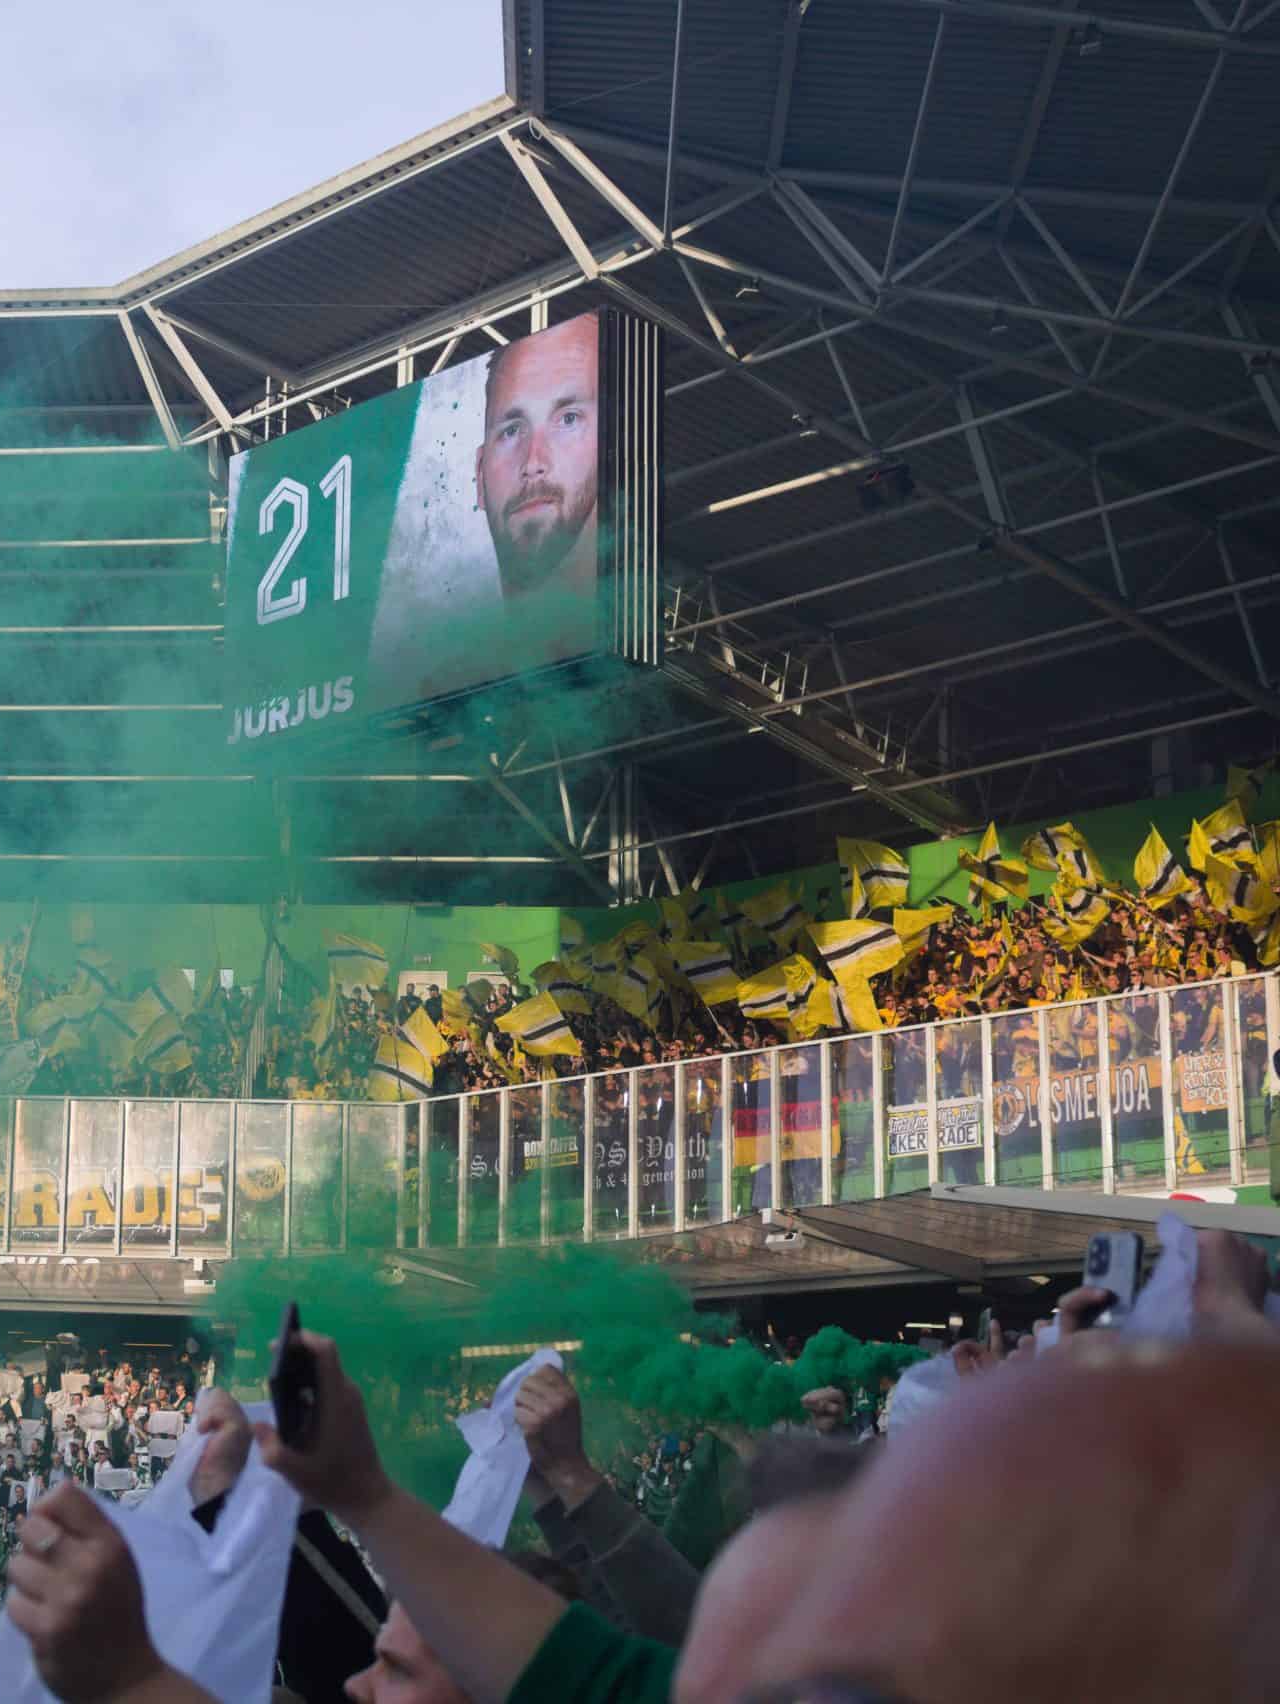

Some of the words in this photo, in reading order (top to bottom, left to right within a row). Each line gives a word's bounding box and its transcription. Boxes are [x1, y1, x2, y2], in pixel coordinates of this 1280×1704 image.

[256, 454, 353, 625] 21
[226, 675, 355, 744] JURJUS
[897, 1125, 976, 1152] KERRADE
